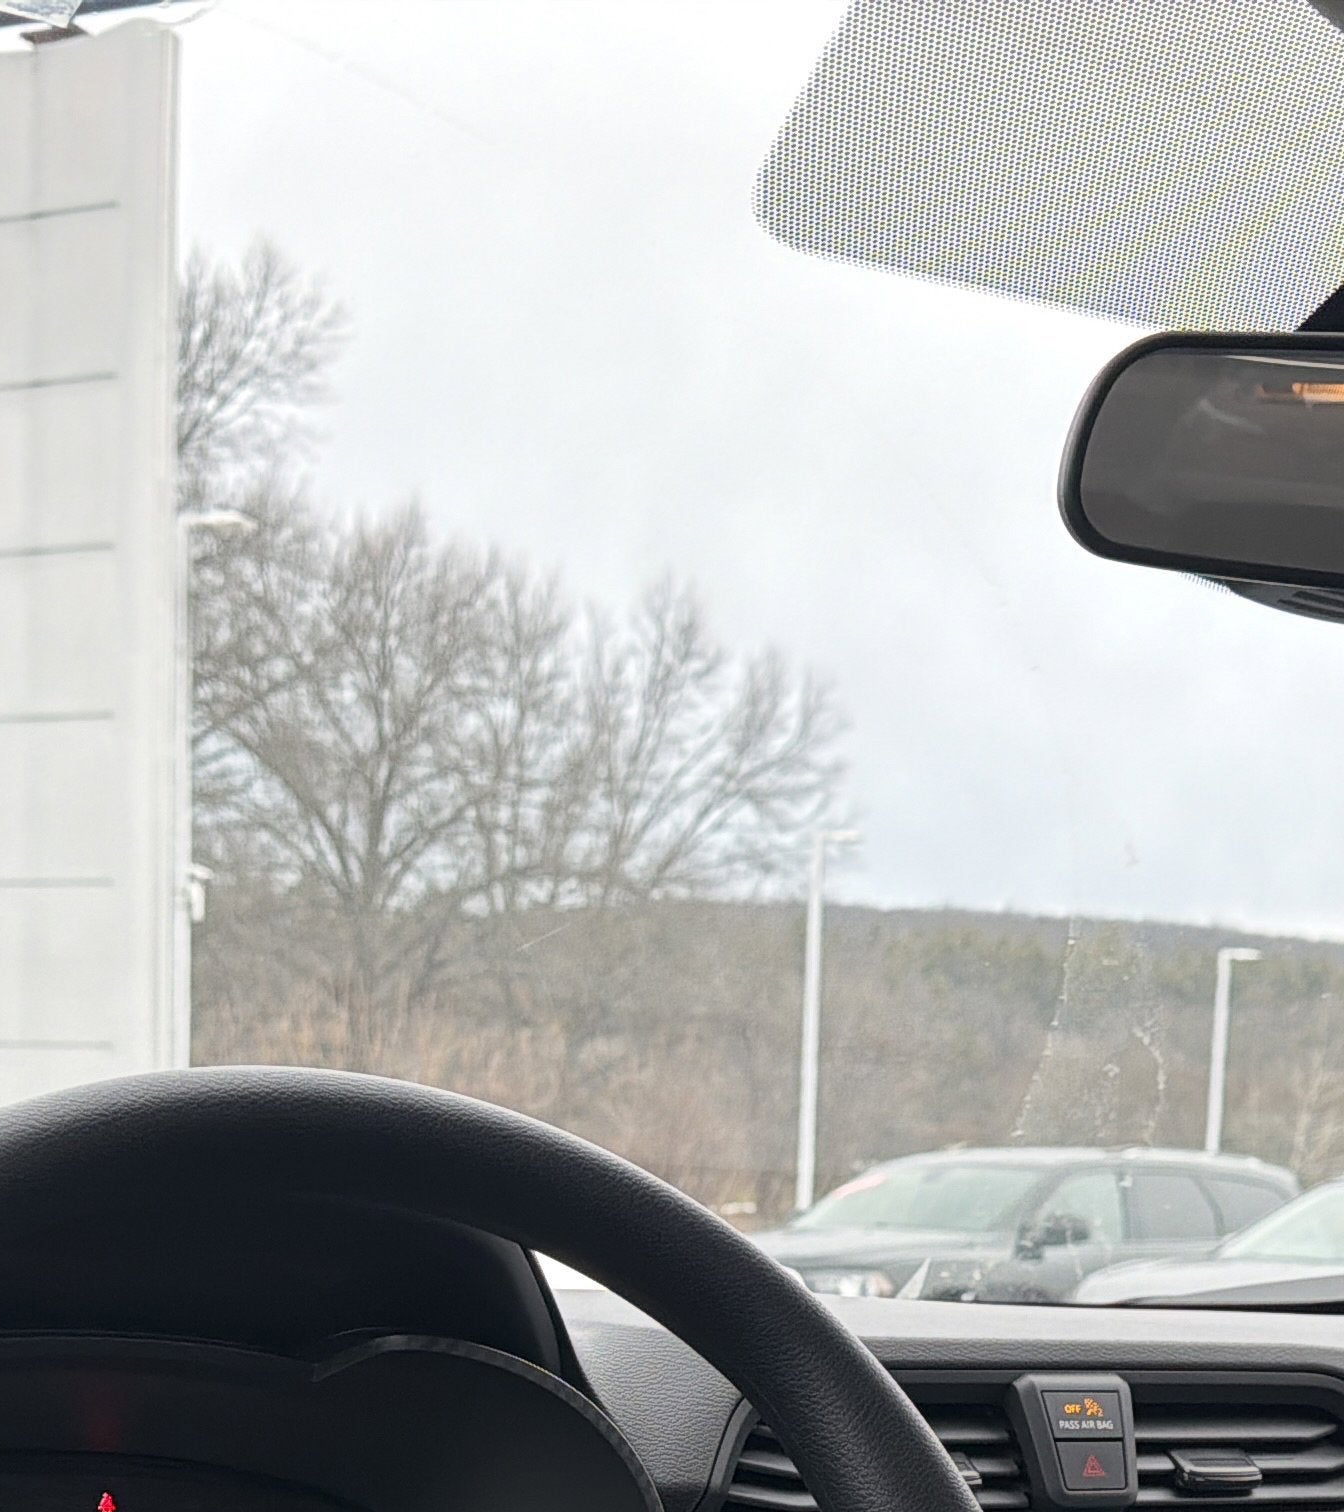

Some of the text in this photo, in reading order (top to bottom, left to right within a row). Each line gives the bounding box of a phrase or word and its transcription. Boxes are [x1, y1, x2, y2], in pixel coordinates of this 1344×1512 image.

[1059, 1420, 1114, 1430] PASS AIR BAG
